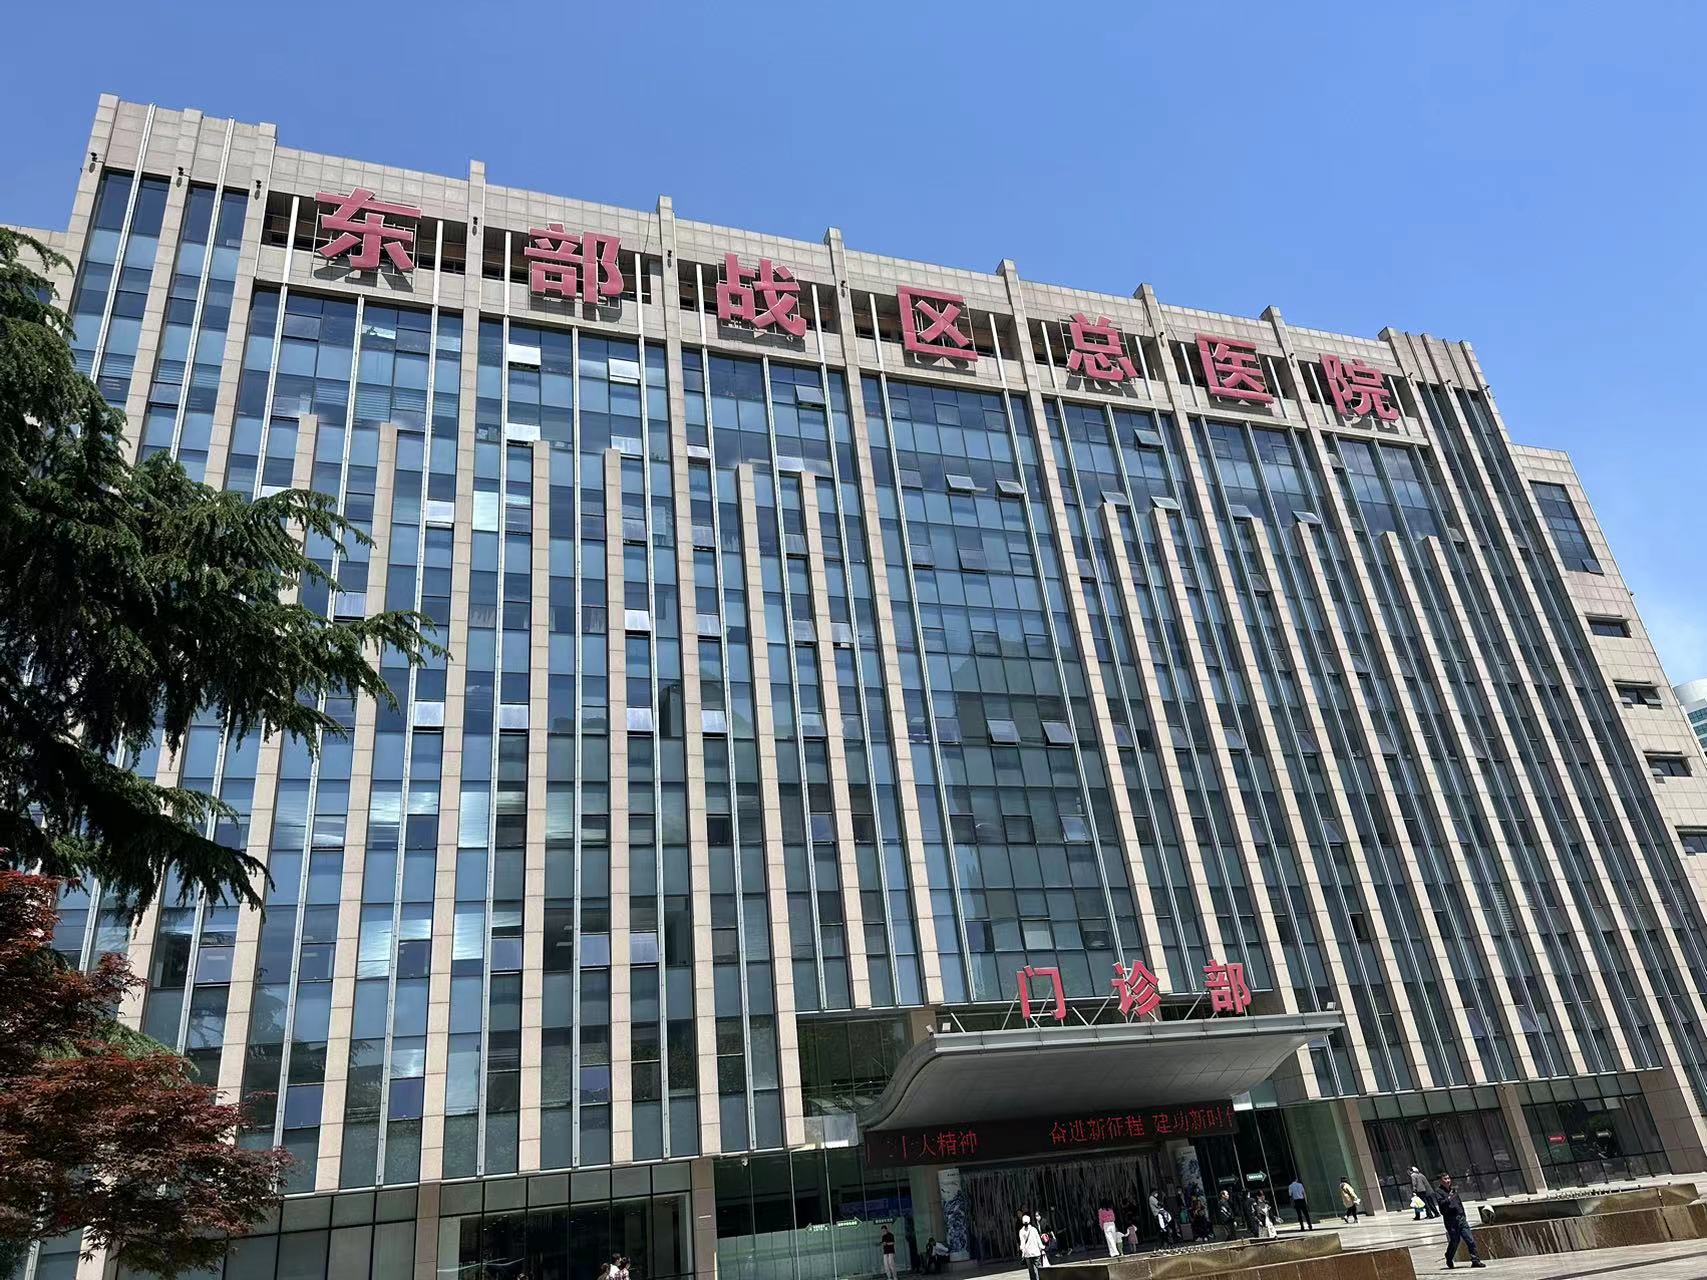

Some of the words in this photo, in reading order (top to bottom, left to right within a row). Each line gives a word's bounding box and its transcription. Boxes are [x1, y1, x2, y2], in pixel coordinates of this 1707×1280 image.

[315, 187, 1400, 421] 东部战区总医院
[1016, 959, 1252, 1020] 门诊部
